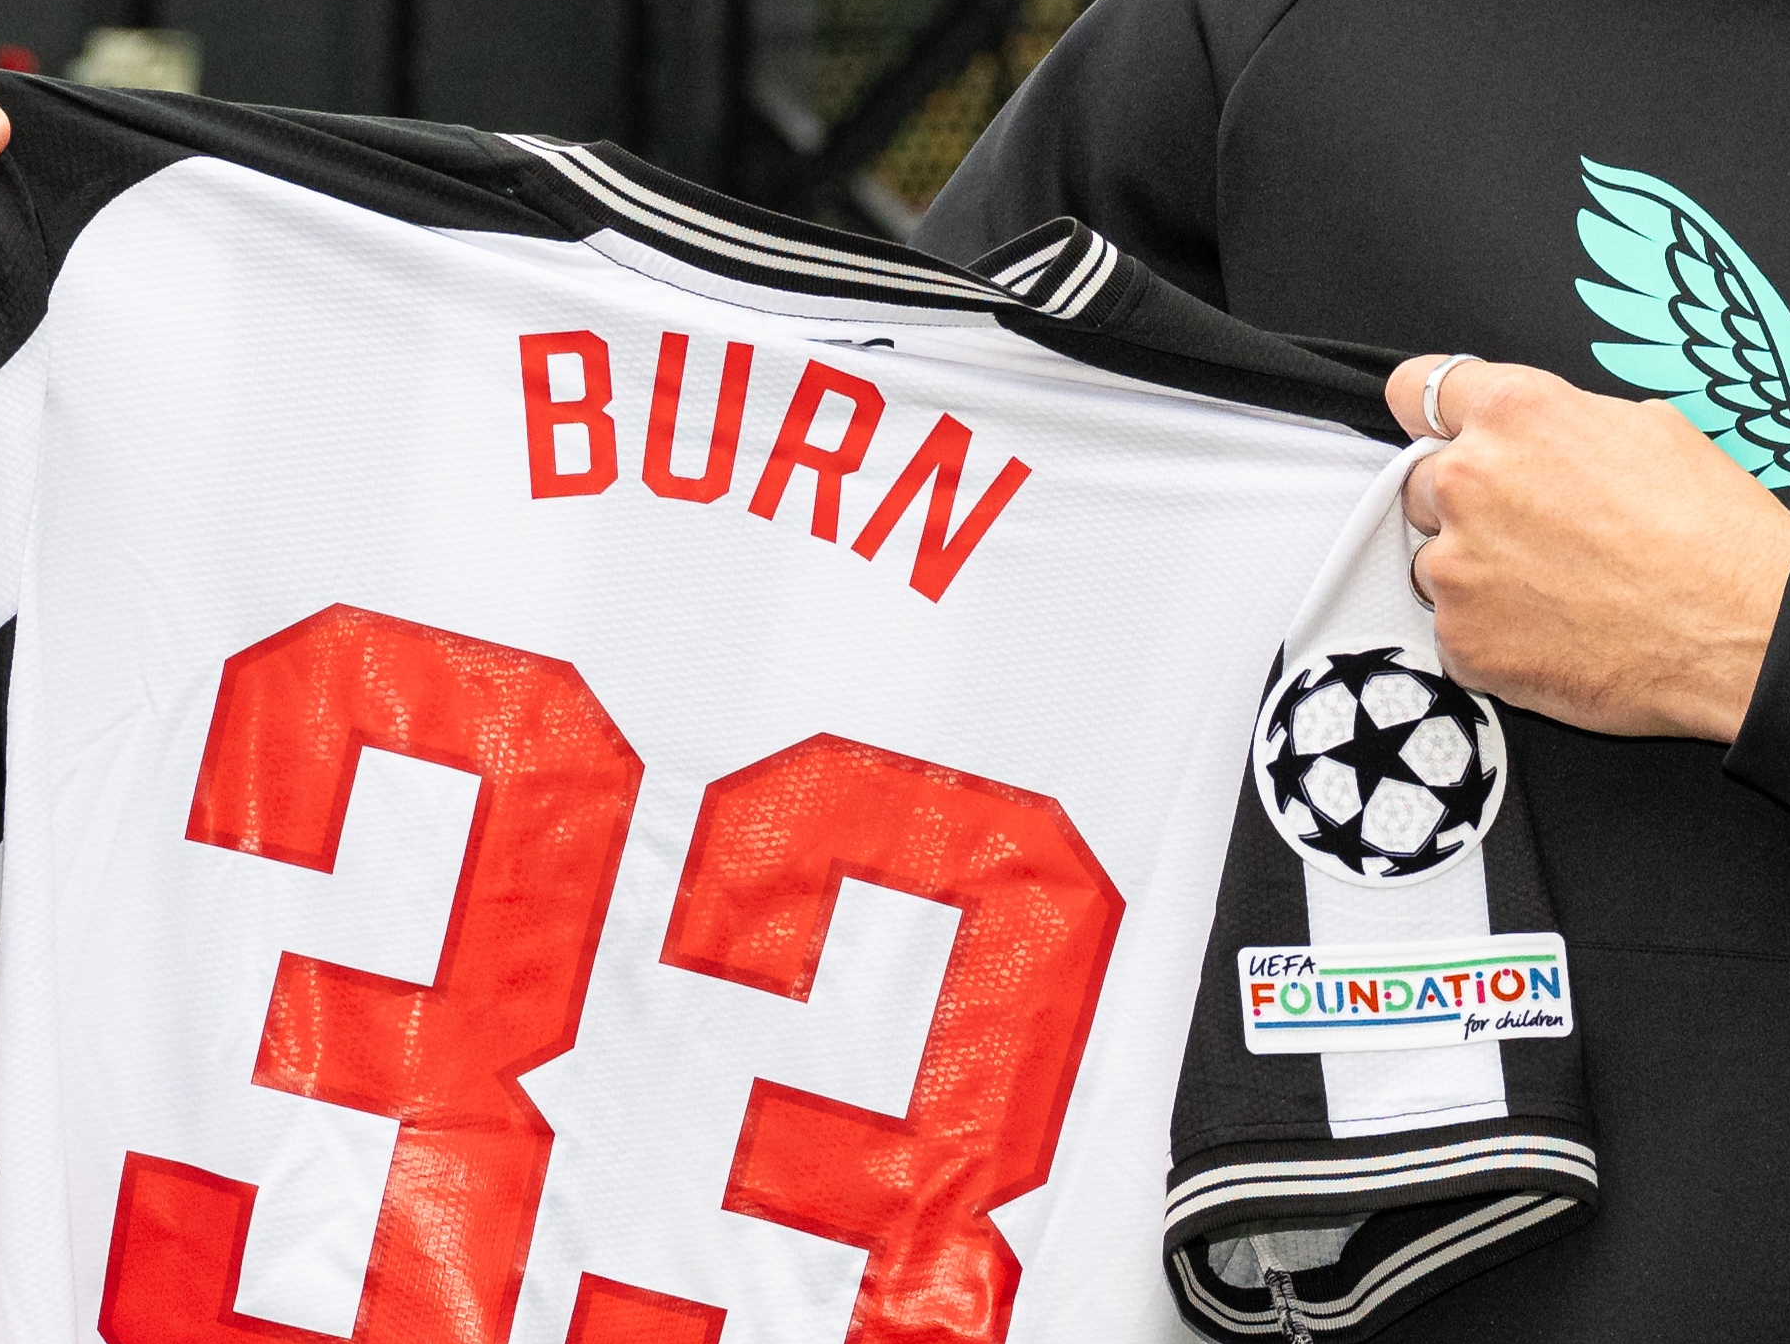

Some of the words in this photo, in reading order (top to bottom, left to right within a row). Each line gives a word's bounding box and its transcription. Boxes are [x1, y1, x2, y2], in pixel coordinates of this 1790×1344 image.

[519, 329, 1033, 604] BURN
[1248, 954, 1317, 978] UEFA
[1463, 1012, 1487, 1041] for
[1495, 1011, 1564, 1031] children
